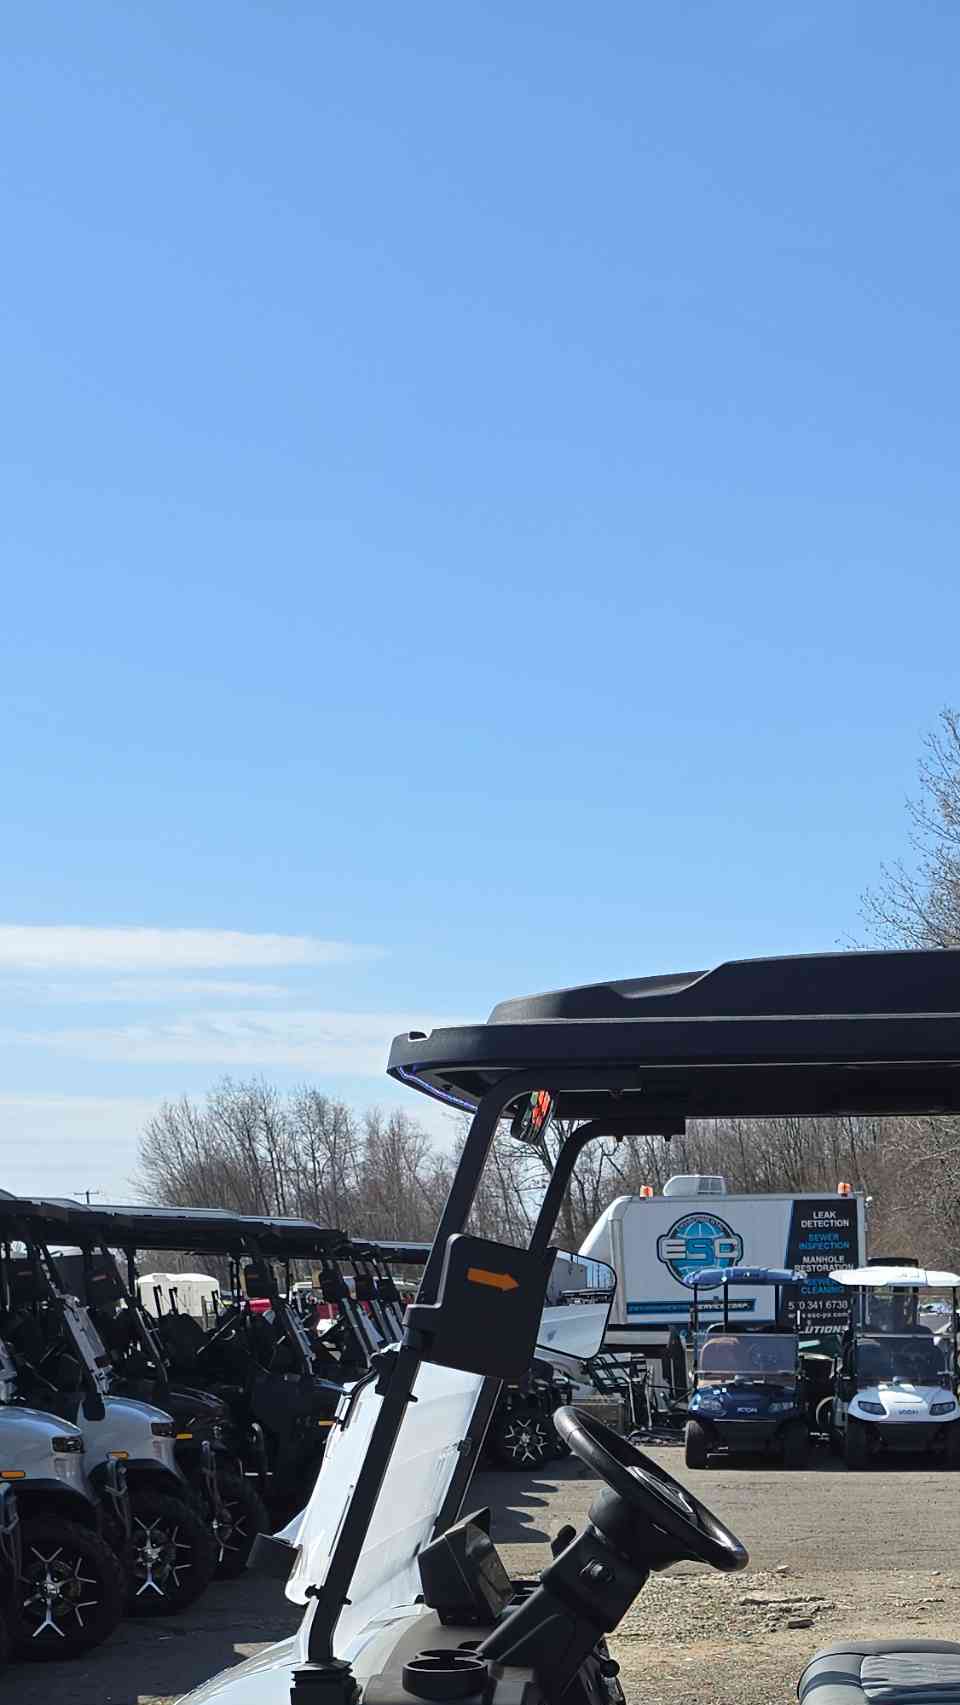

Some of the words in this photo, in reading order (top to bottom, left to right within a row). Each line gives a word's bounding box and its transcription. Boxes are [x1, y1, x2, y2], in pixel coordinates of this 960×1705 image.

[813, 1211, 836, 1219] LEAK
[801, 1219, 849, 1228] DETECTION
[802, 1255, 845, 1264] MANHOLE
[788, 1301, 806, 1310] 50
